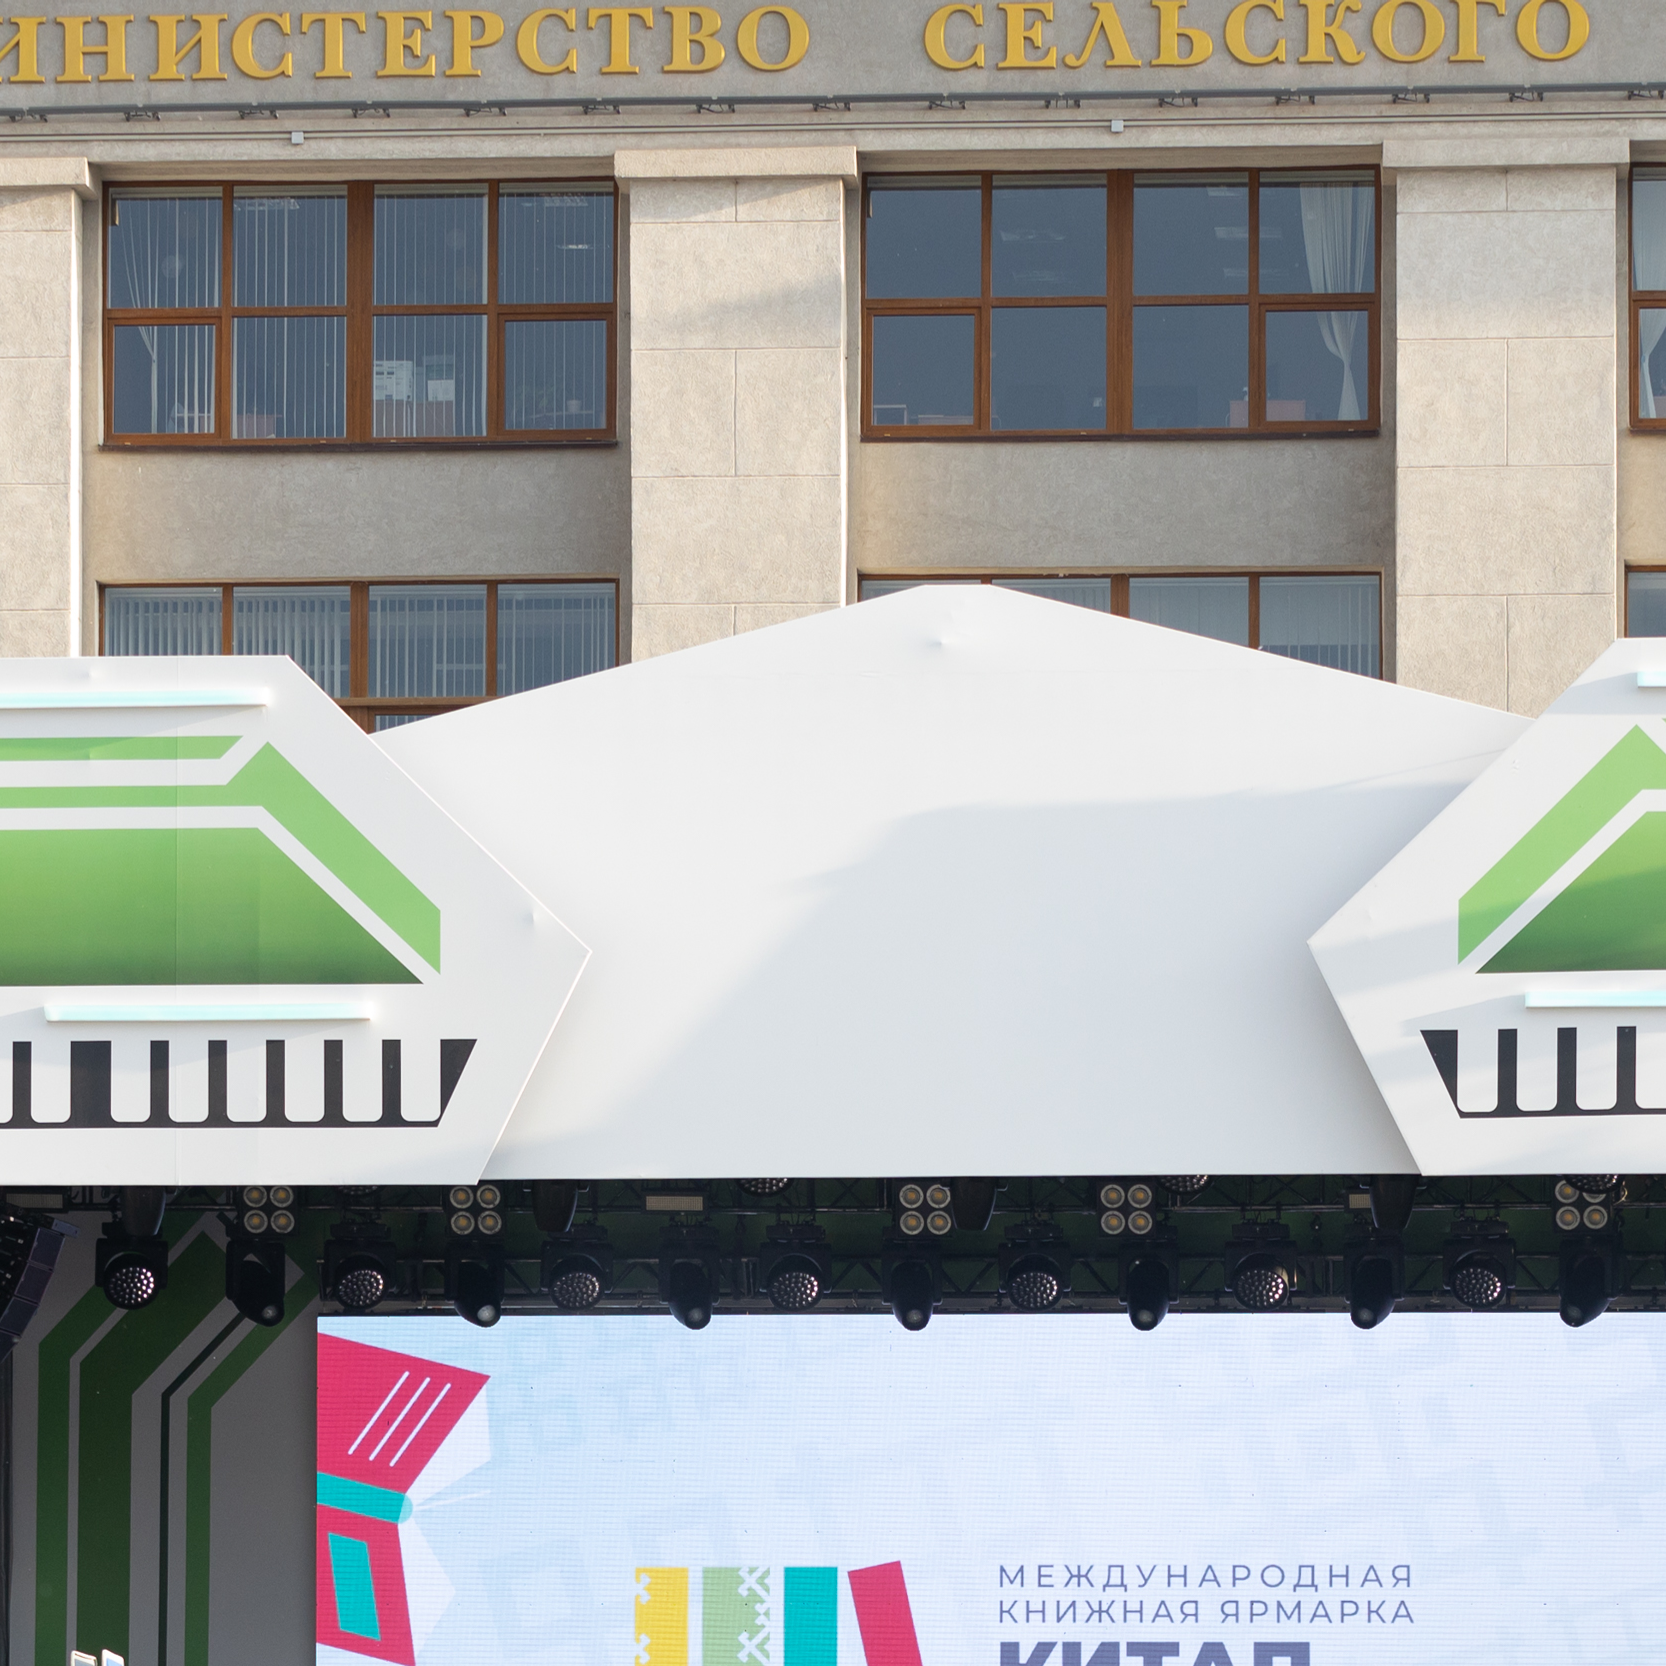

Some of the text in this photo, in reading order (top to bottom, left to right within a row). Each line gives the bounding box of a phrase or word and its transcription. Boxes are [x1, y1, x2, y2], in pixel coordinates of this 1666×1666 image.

[923, 0, 1590, 70] СЕЛЬСКОГО
[999, 1564, 1413, 1593] МЕЖДУНАРОДНАЯ
[999, 1600, 1416, 1624] КНИЖНАЯ ЯРМАРКА
